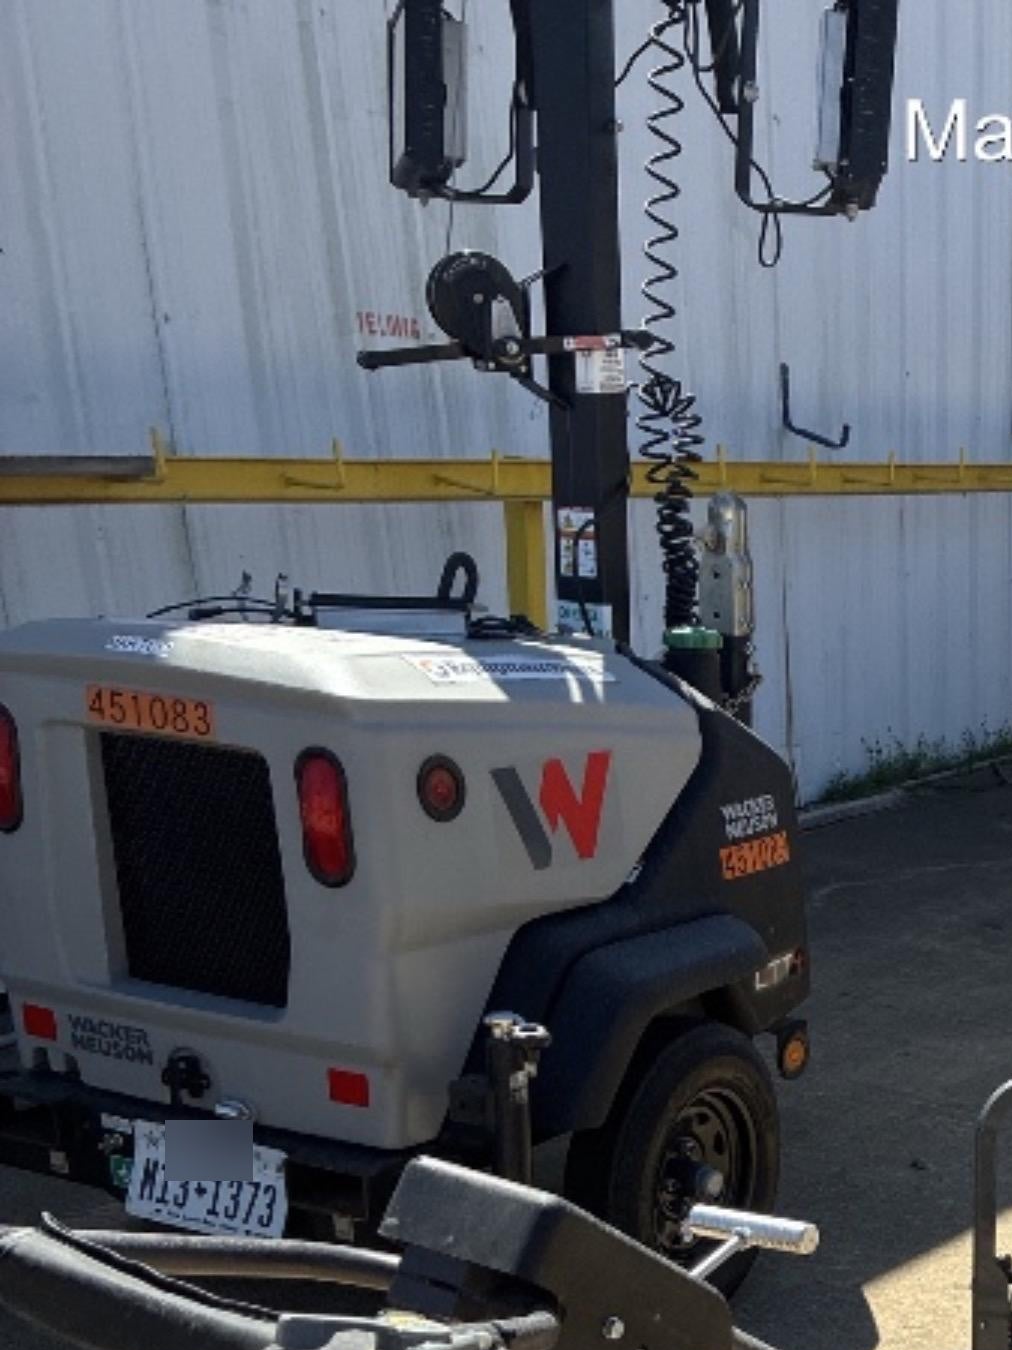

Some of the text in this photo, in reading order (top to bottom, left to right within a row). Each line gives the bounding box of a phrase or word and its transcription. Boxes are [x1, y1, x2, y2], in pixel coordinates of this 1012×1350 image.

[88, 687, 211, 737] 451083
[67, 1013, 151, 1049] WACKER
[71, 1031, 154, 1067] NEUSON
